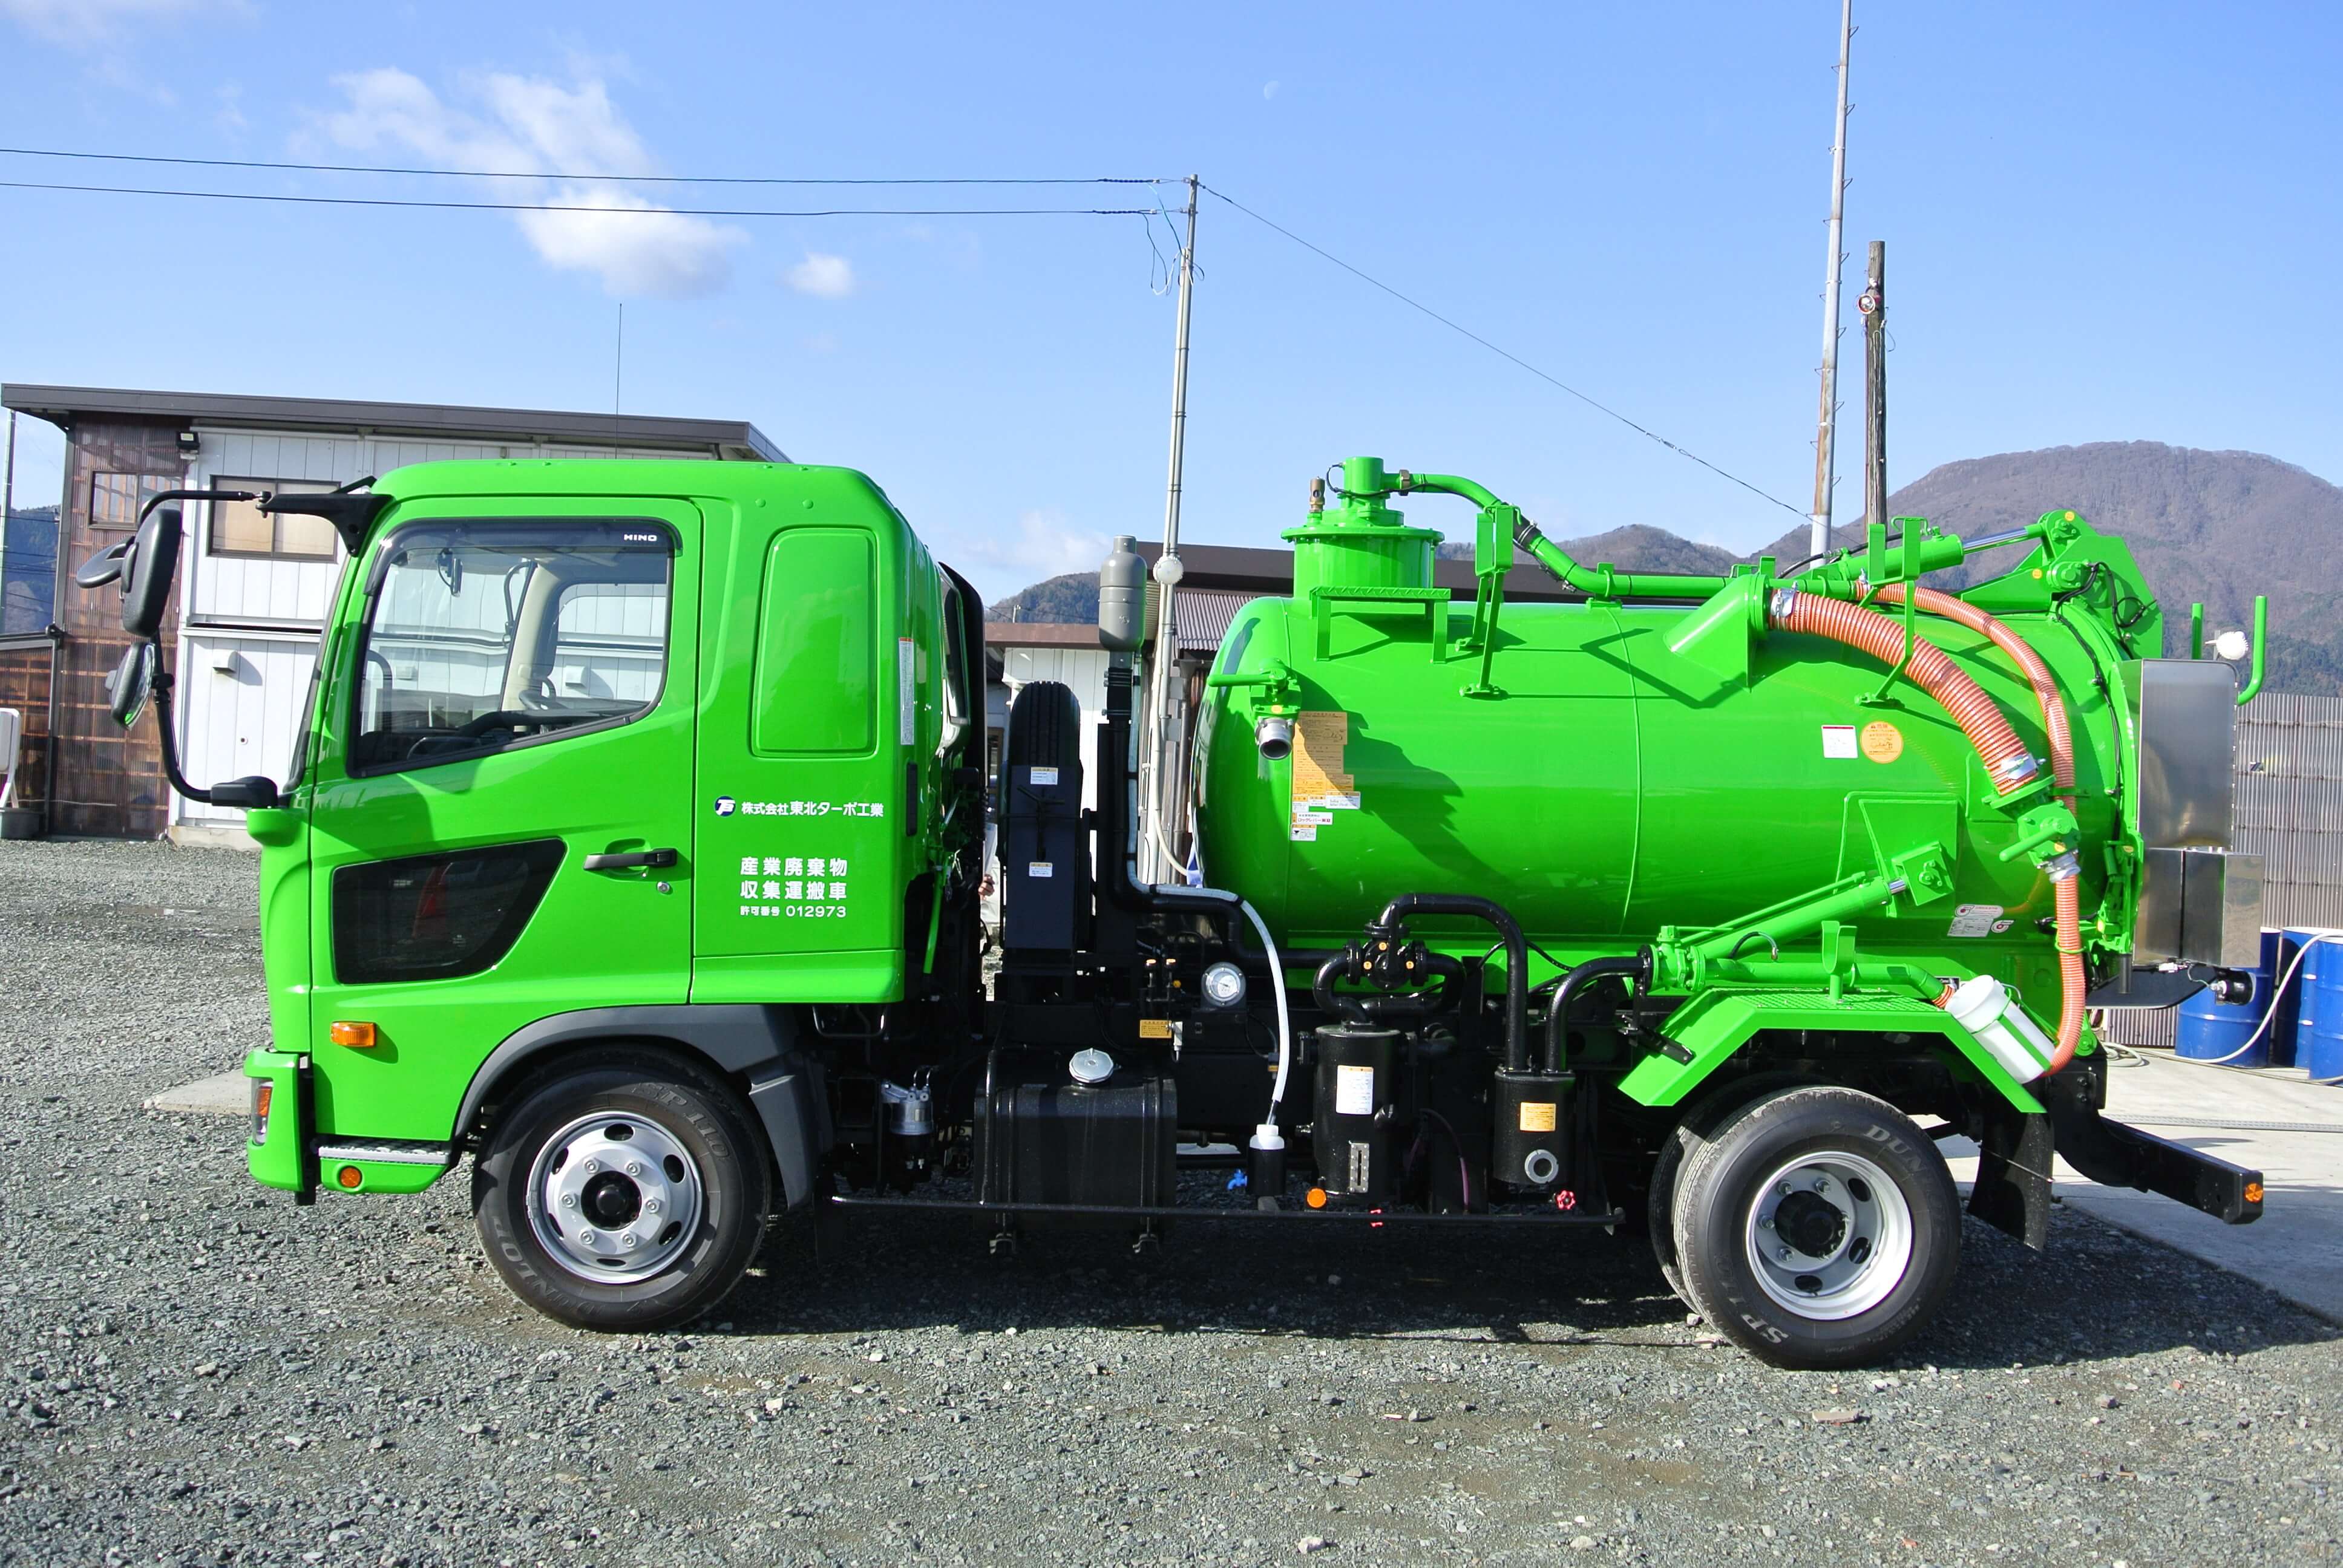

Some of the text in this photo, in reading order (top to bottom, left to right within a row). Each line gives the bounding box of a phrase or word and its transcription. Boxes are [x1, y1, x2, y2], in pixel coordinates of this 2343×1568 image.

[741, 801, 884, 817] 株式会社東北ターボ工業
[740, 857, 847, 877] 産業廃棄物
[740, 880, 847, 900] 収集運搬車
[740, 906, 846, 918] 許可番号 012973
